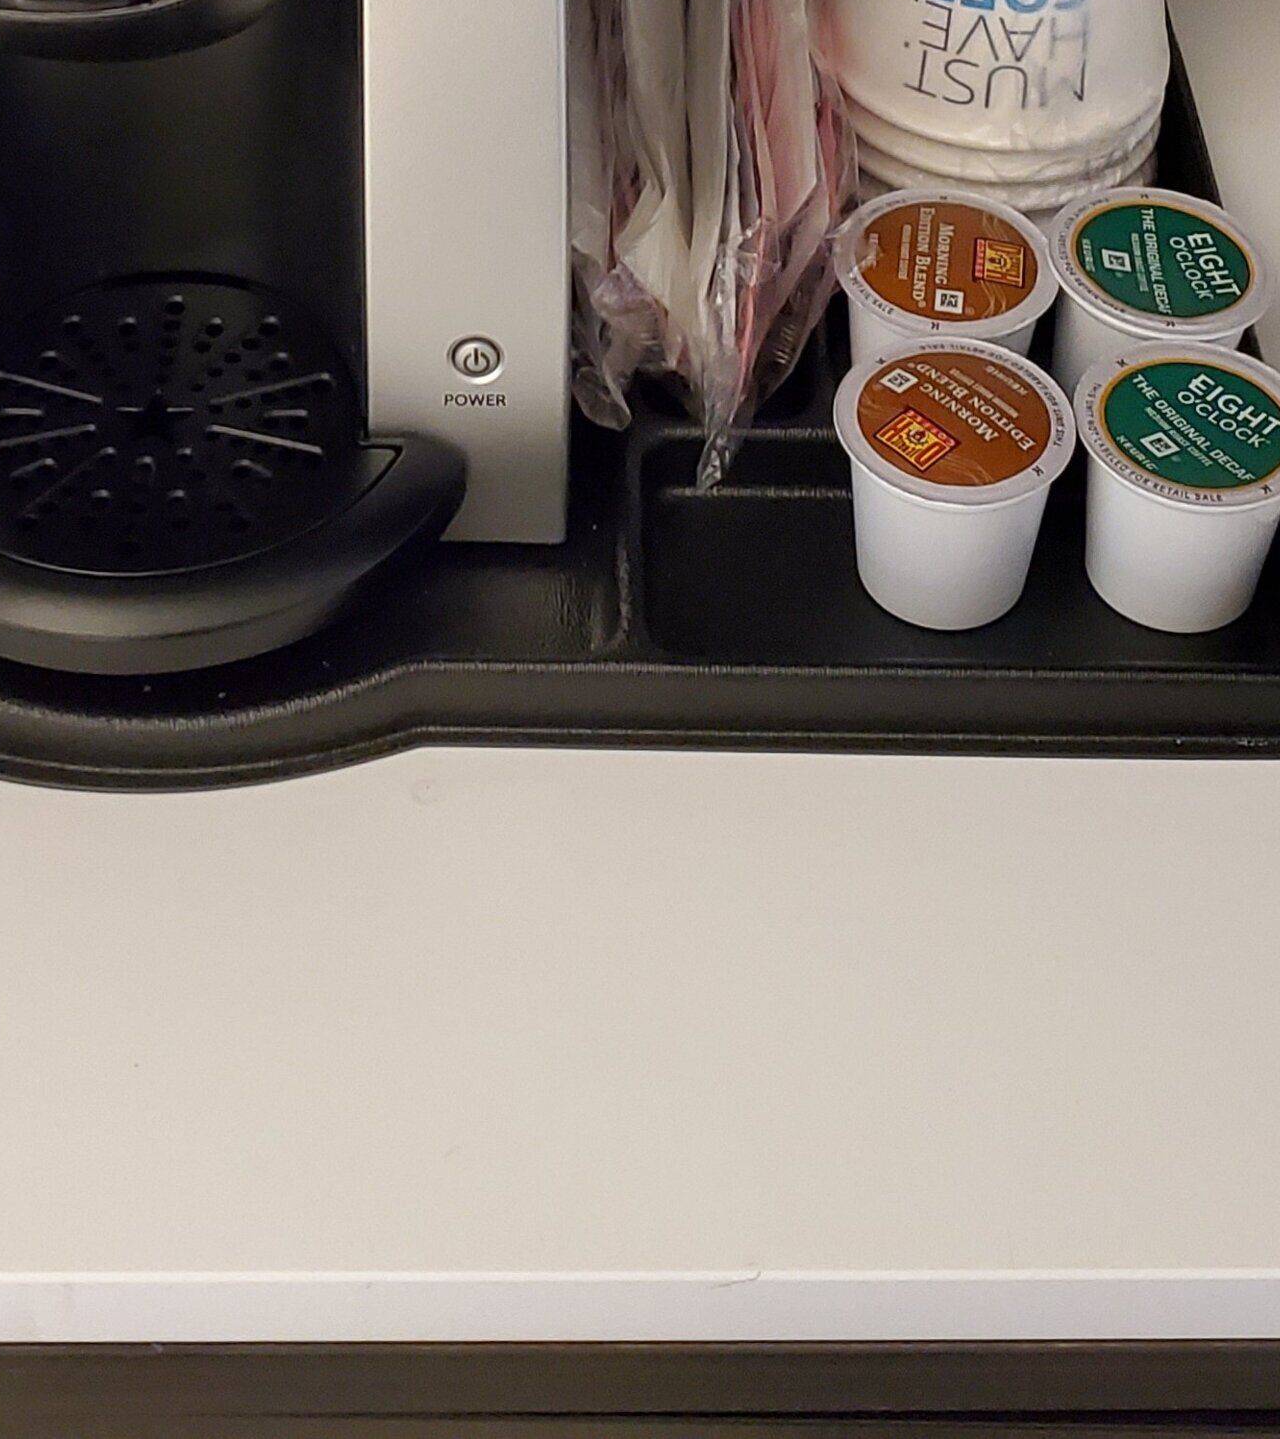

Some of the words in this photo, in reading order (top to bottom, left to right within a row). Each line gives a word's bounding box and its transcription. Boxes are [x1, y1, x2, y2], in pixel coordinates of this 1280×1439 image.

[1141, 208, 1156, 232] THE
[934, 222, 956, 286] MORNING
[1169, 236, 1214, 301] O'CLOCK
[1187, 232, 1242, 297] EIGHT
[443, 393, 507, 407] POWER
[919, 382, 1000, 442] MORNING
[968, 396, 1036, 451] EDITION
[1132, 374, 1157, 400] THE
[1155, 399, 1211, 451] ORIGINAL
[1208, 449, 1256, 482] DECAF
[1177, 391, 1266, 449] O'CLOCK
[1194, 492, 1224, 503] SALE
